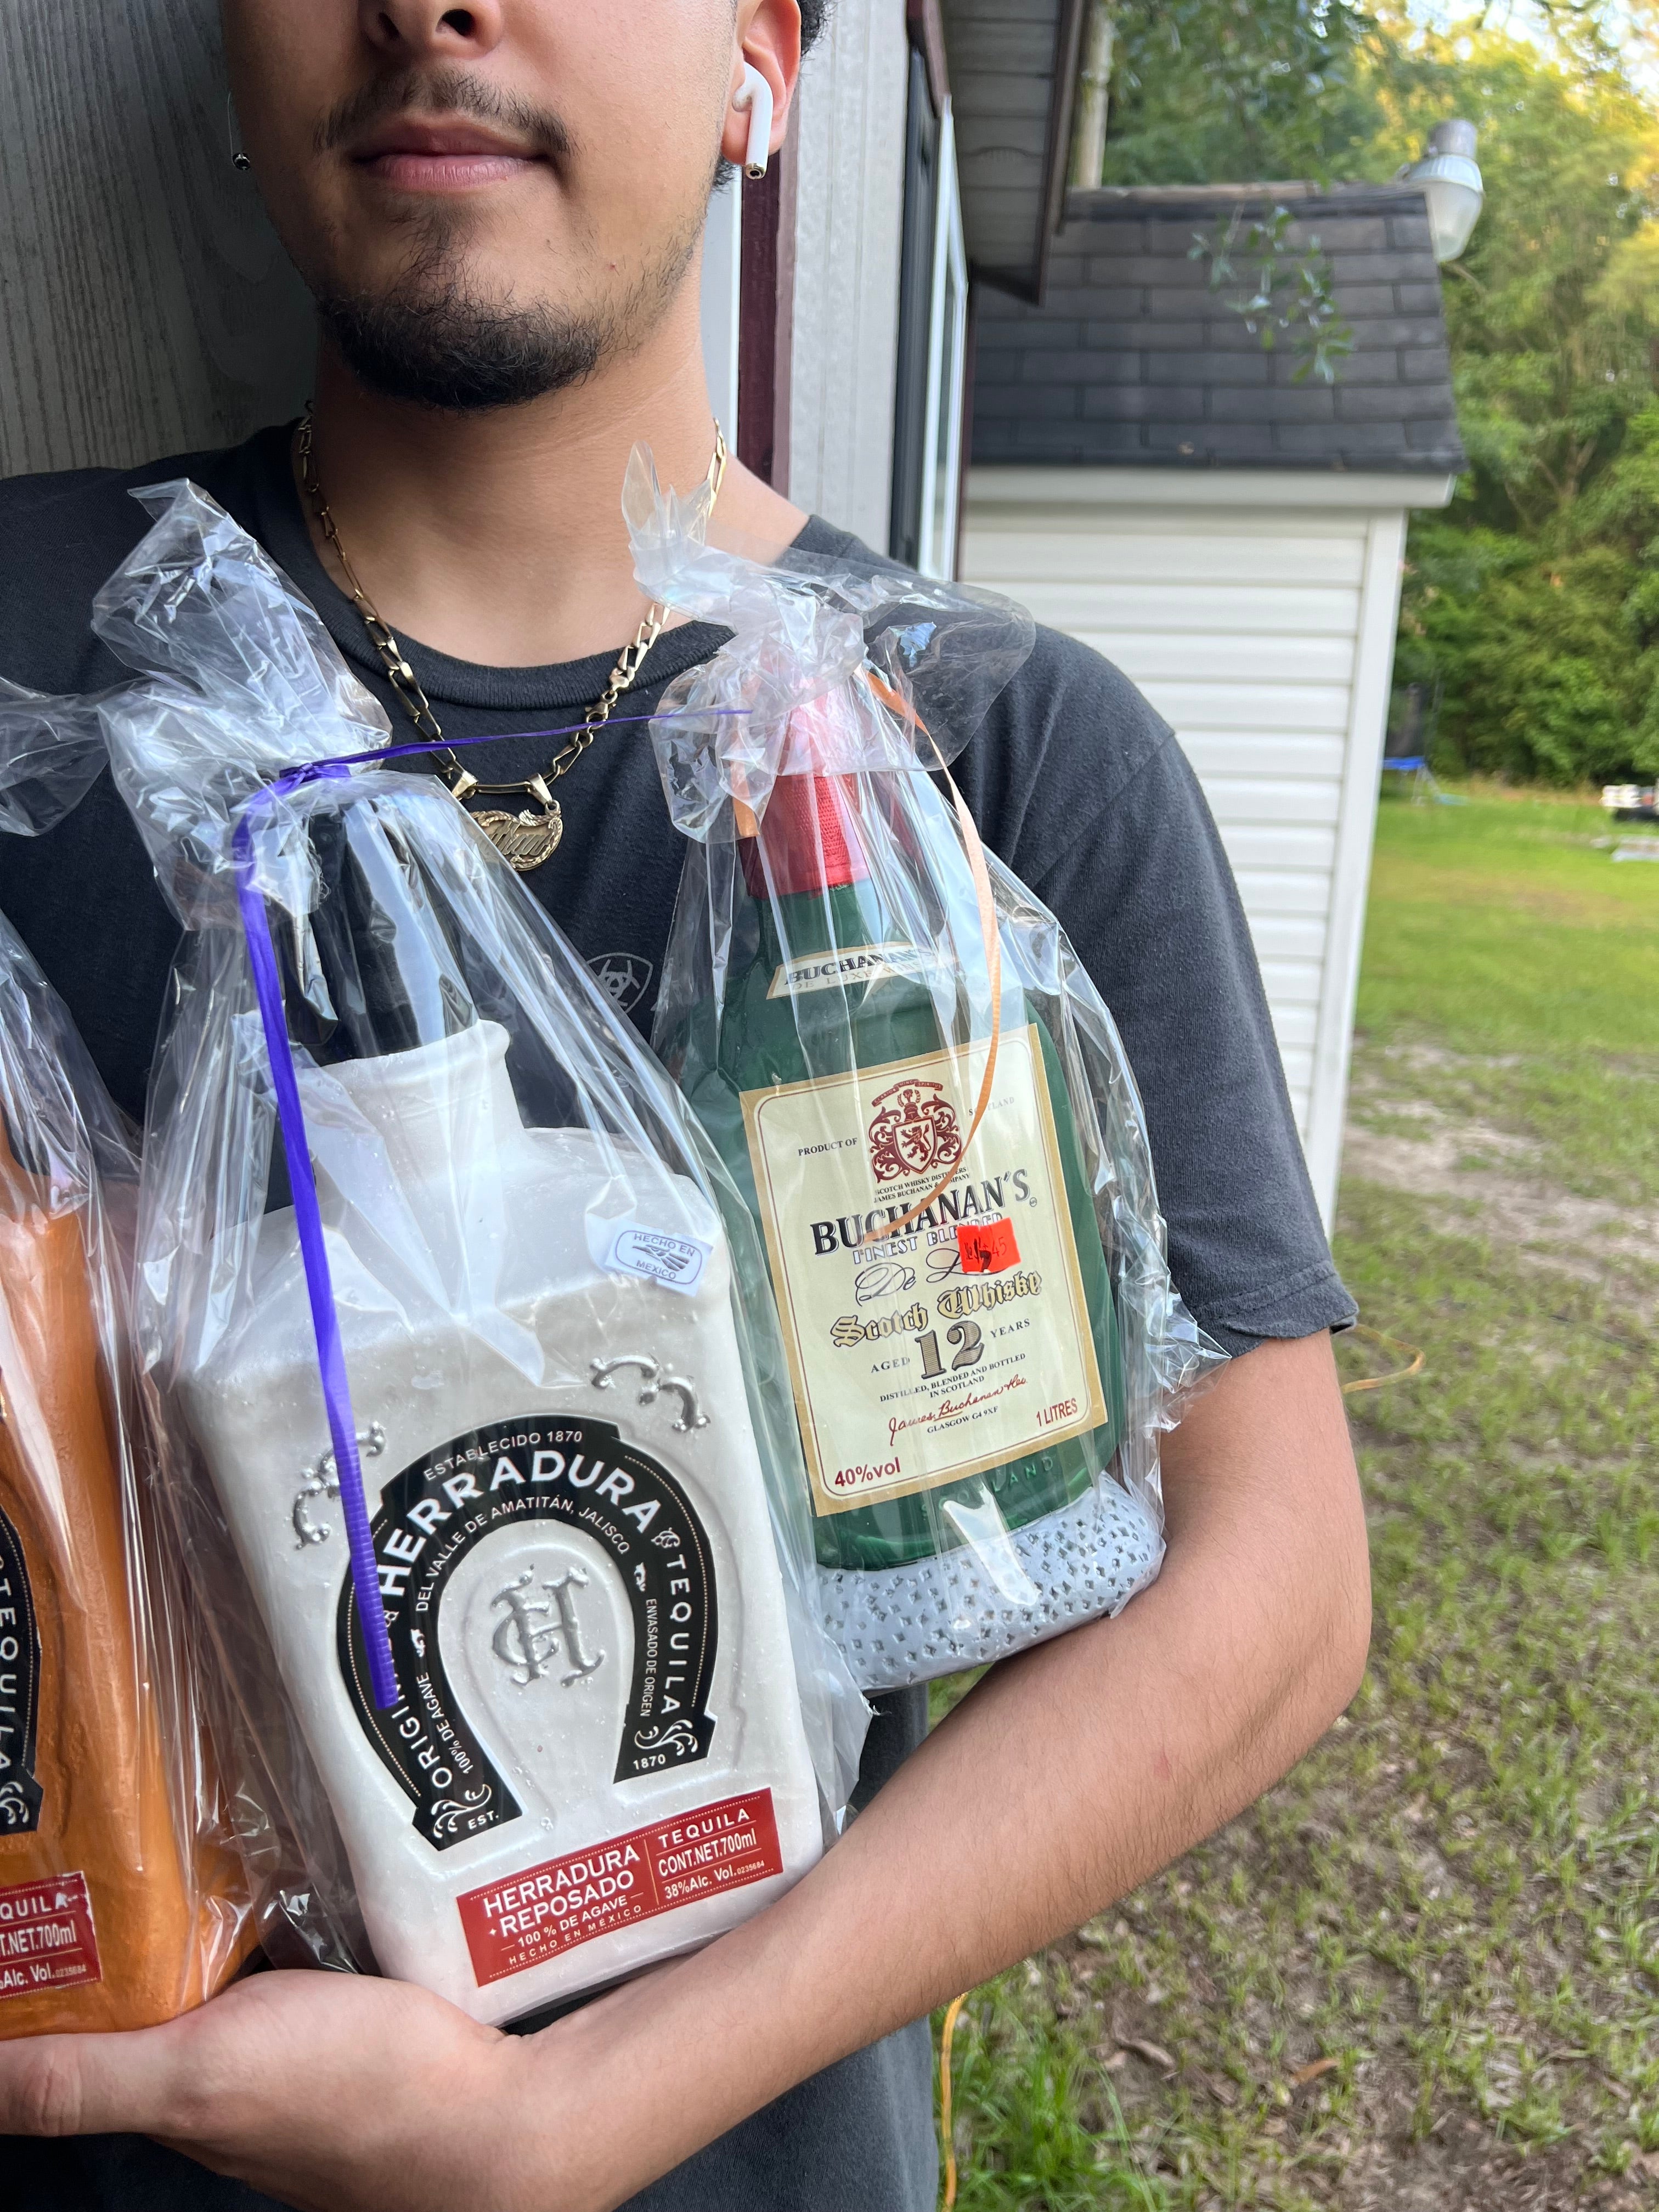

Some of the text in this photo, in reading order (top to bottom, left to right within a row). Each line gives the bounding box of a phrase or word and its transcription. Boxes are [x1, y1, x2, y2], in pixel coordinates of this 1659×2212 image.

[969, 1097, 1014, 1116] STLAND
[798, 1137, 857, 1156] PRODUCT OF
[874, 1193, 896, 1203] JAMES
[898, 1183, 933, 1198] BUCHANAN
[942, 1173, 970, 1186] MPANY
[876, 1183, 903, 1195] SCOTCH
[904, 1176, 930, 1188] WHISKY
[810, 1168, 1031, 1256] BUCHANAN'S
[634, 1233, 696, 1257] HECHO EN
[853, 1235, 918, 1265] FINEST
[636, 1260, 676, 1279] MEXICO
[855, 1262, 917, 1307] De
[830, 1302, 928, 1348] Scotch
[870, 1318, 1030, 1380] AGED 12 YEARS
[880, 1352, 1026, 1402] DISTILLED, BLENDED AND BOTTLED
[930, 1375, 985, 1398] IN SCOTLAND
[927, 1406, 998, 1434] GLASGOW G4 9XF
[1036, 1397, 1078, 1427] 1 LITRES
[423, 1430, 583, 1481] ESTABLECIDO 1870
[834, 1456, 901, 1487] 40%vol
[377, 1450, 662, 1598] HERRADURA
[416, 1494, 630, 1612] DEL VALLE DE AMATITÁN, JALISCO
[661, 1554, 693, 1714] TEQUILA
[640, 1598, 659, 1718] ENVASADO DE ORIGEN
[416, 1671, 475, 1775] 100% DE AGAVE
[633, 1753, 667, 1770] 1870
[467, 1809, 499, 1830] EST.
[658, 1808, 750, 1848] TEQUILA
[483, 1844, 641, 1918] HERRADURA
[664, 1875, 713, 1899] 38%Alc.
[499, 1870, 634, 1938] REPOSADO
[517, 1931, 541, 1948] 100
[559, 1915, 579, 1932] DE
[582, 1895, 627, 1923] AGAVE
[509, 1904, 642, 1966] HECHO EN MÉXICO
